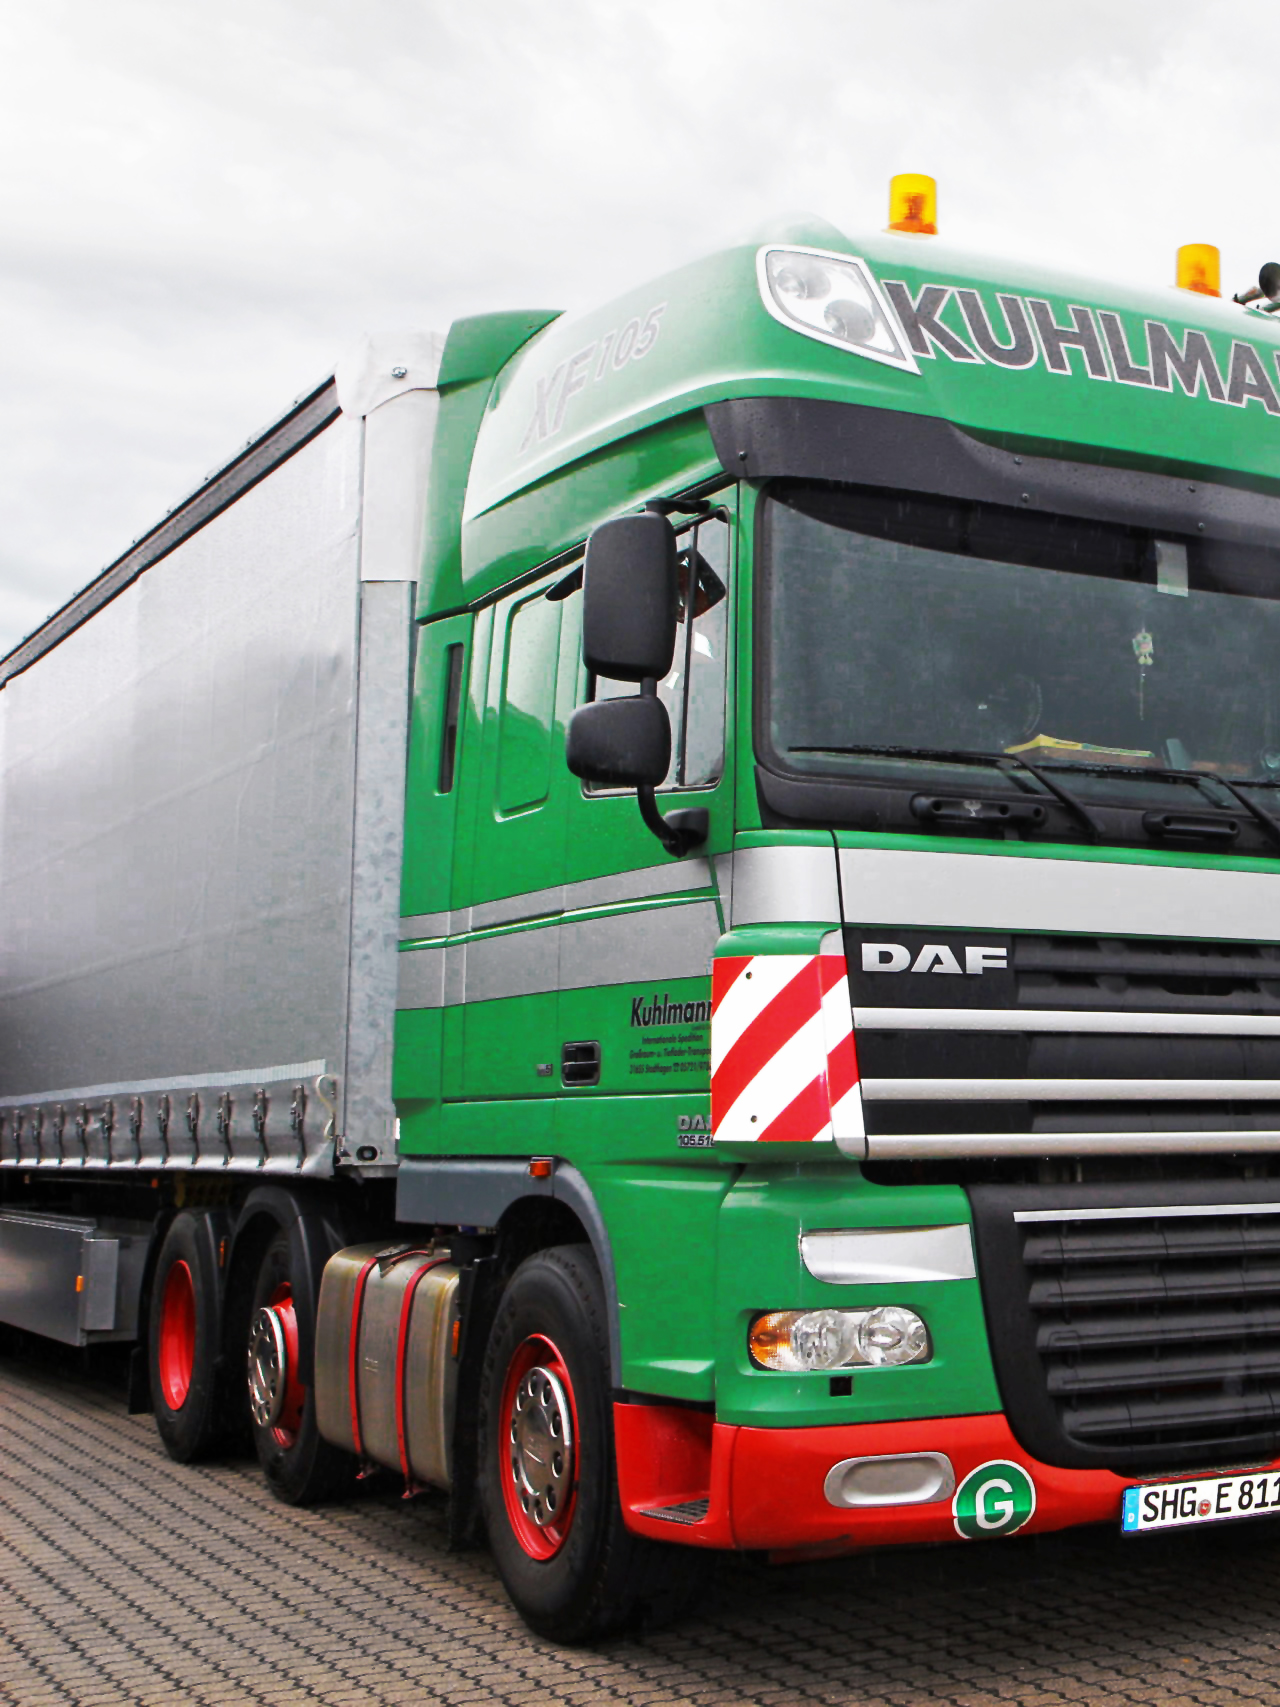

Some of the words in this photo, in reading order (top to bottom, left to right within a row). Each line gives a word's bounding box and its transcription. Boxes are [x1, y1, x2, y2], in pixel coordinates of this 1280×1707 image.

[517, 338, 599, 458] XF
[594, 301, 669, 382] 105
[861, 943, 1008, 975] DAF
[975, 1479, 1014, 1530] G
[1142, 1486, 1197, 1523] SHG
[1215, 1482, 1233, 1514] E
